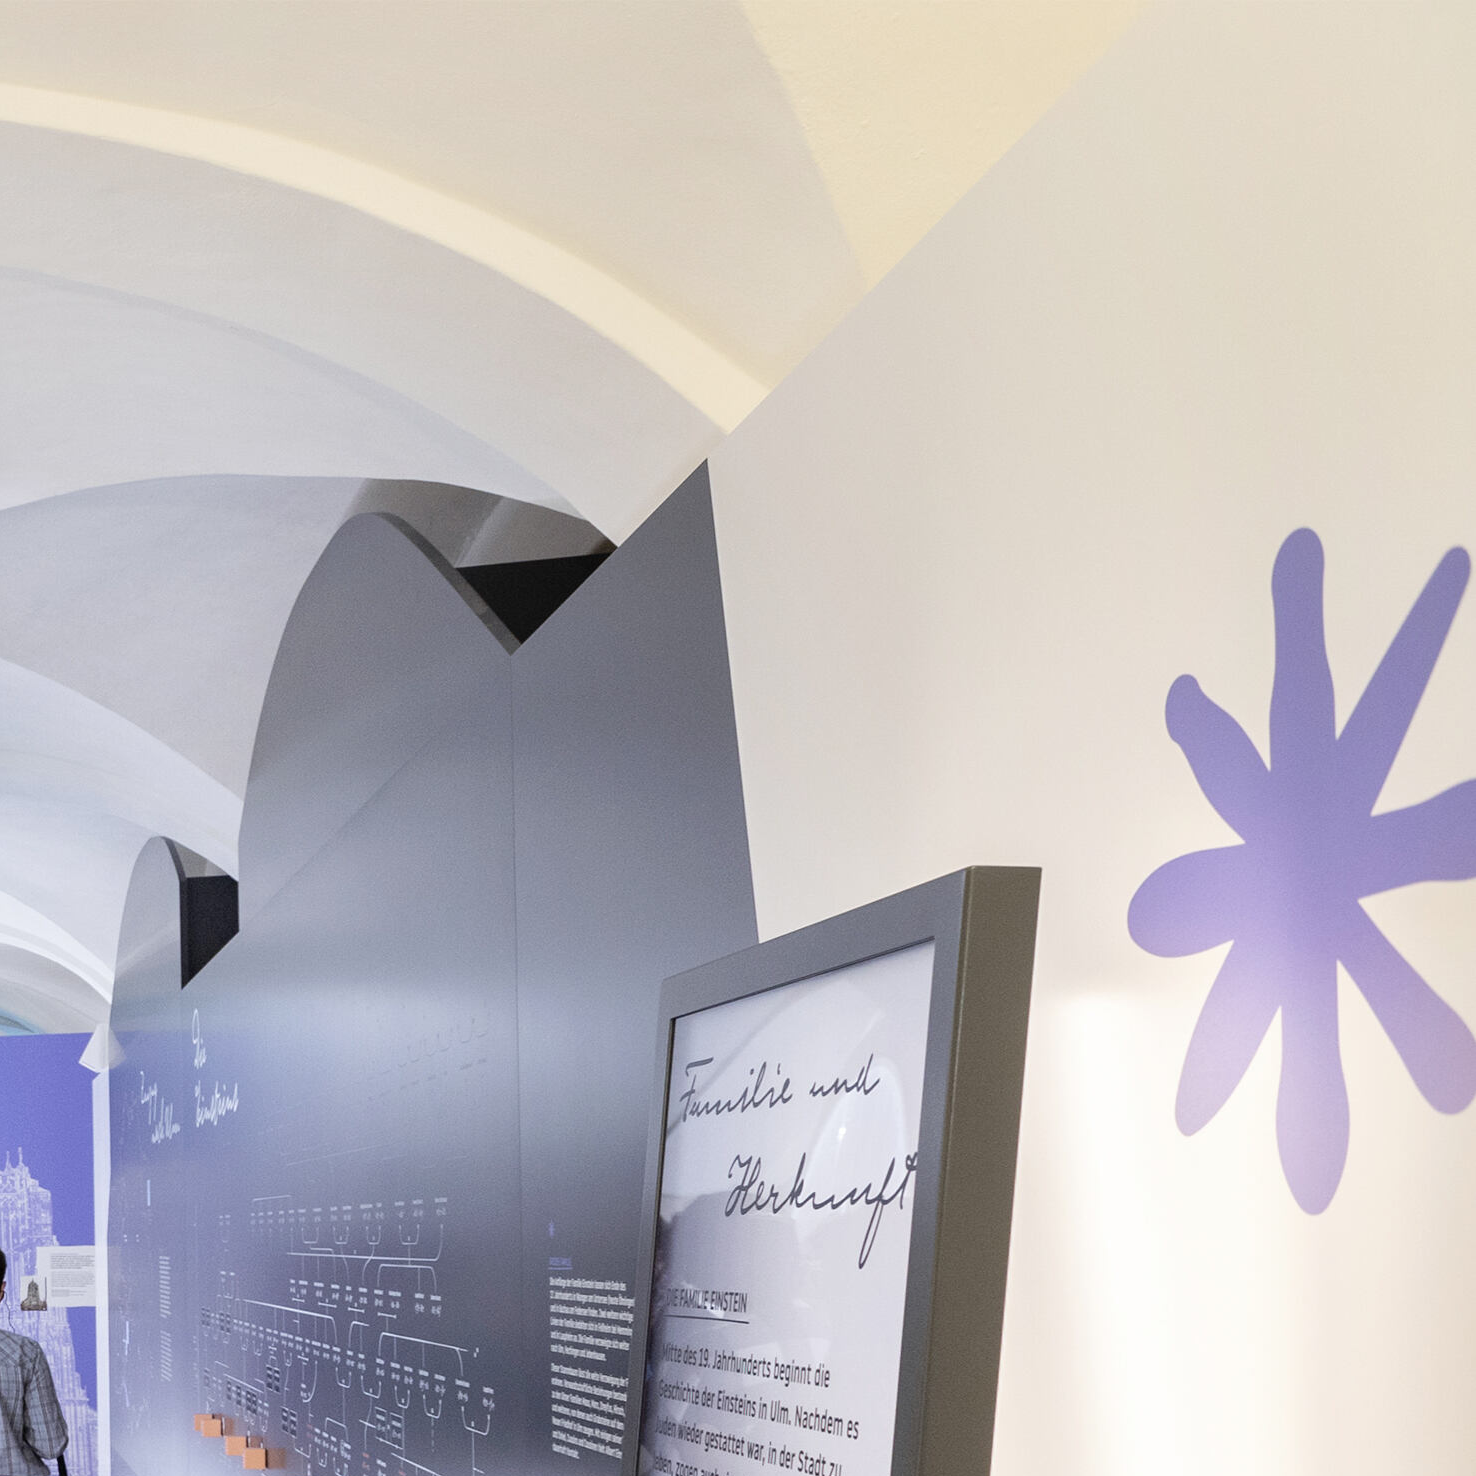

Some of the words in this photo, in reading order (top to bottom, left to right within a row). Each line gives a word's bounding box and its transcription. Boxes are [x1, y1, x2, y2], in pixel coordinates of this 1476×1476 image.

[680, 1056, 792, 1123] Familie
[810, 1054, 880, 1097] und
[725, 1152, 918, 1269] Herkunft
[666, 1288, 677, 1306] DIE
[677, 1289, 708, 1309] FAMILIE
[709, 1291, 747, 1313] EINSTEIN
[683, 1345, 696, 1366] des
[698, 1348, 710, 1368] 19.
[711, 1350, 771, 1378] Jahrhunderts
[773, 1357, 811, 1388] beginnt
[814, 1363, 830, 1388] die
[658, 1379, 699, 1405] Geschichte
[701, 1386, 715, 1408] der
[717, 1391, 756, 1417] Einsteins
[758, 1398, 767, 1420] in
[770, 1401, 791, 1425] Ulm.
[795, 1407, 843, 1436] Nachdem
[847, 1421, 859, 1440] es
[677, 1421, 703, 1445] wieder
[704, 1431, 744, 1456] gestattet
[747, 1442, 765, 1465] war,
[767, 1441, 777, 1464] in
[779, 1444, 795, 1469] der
